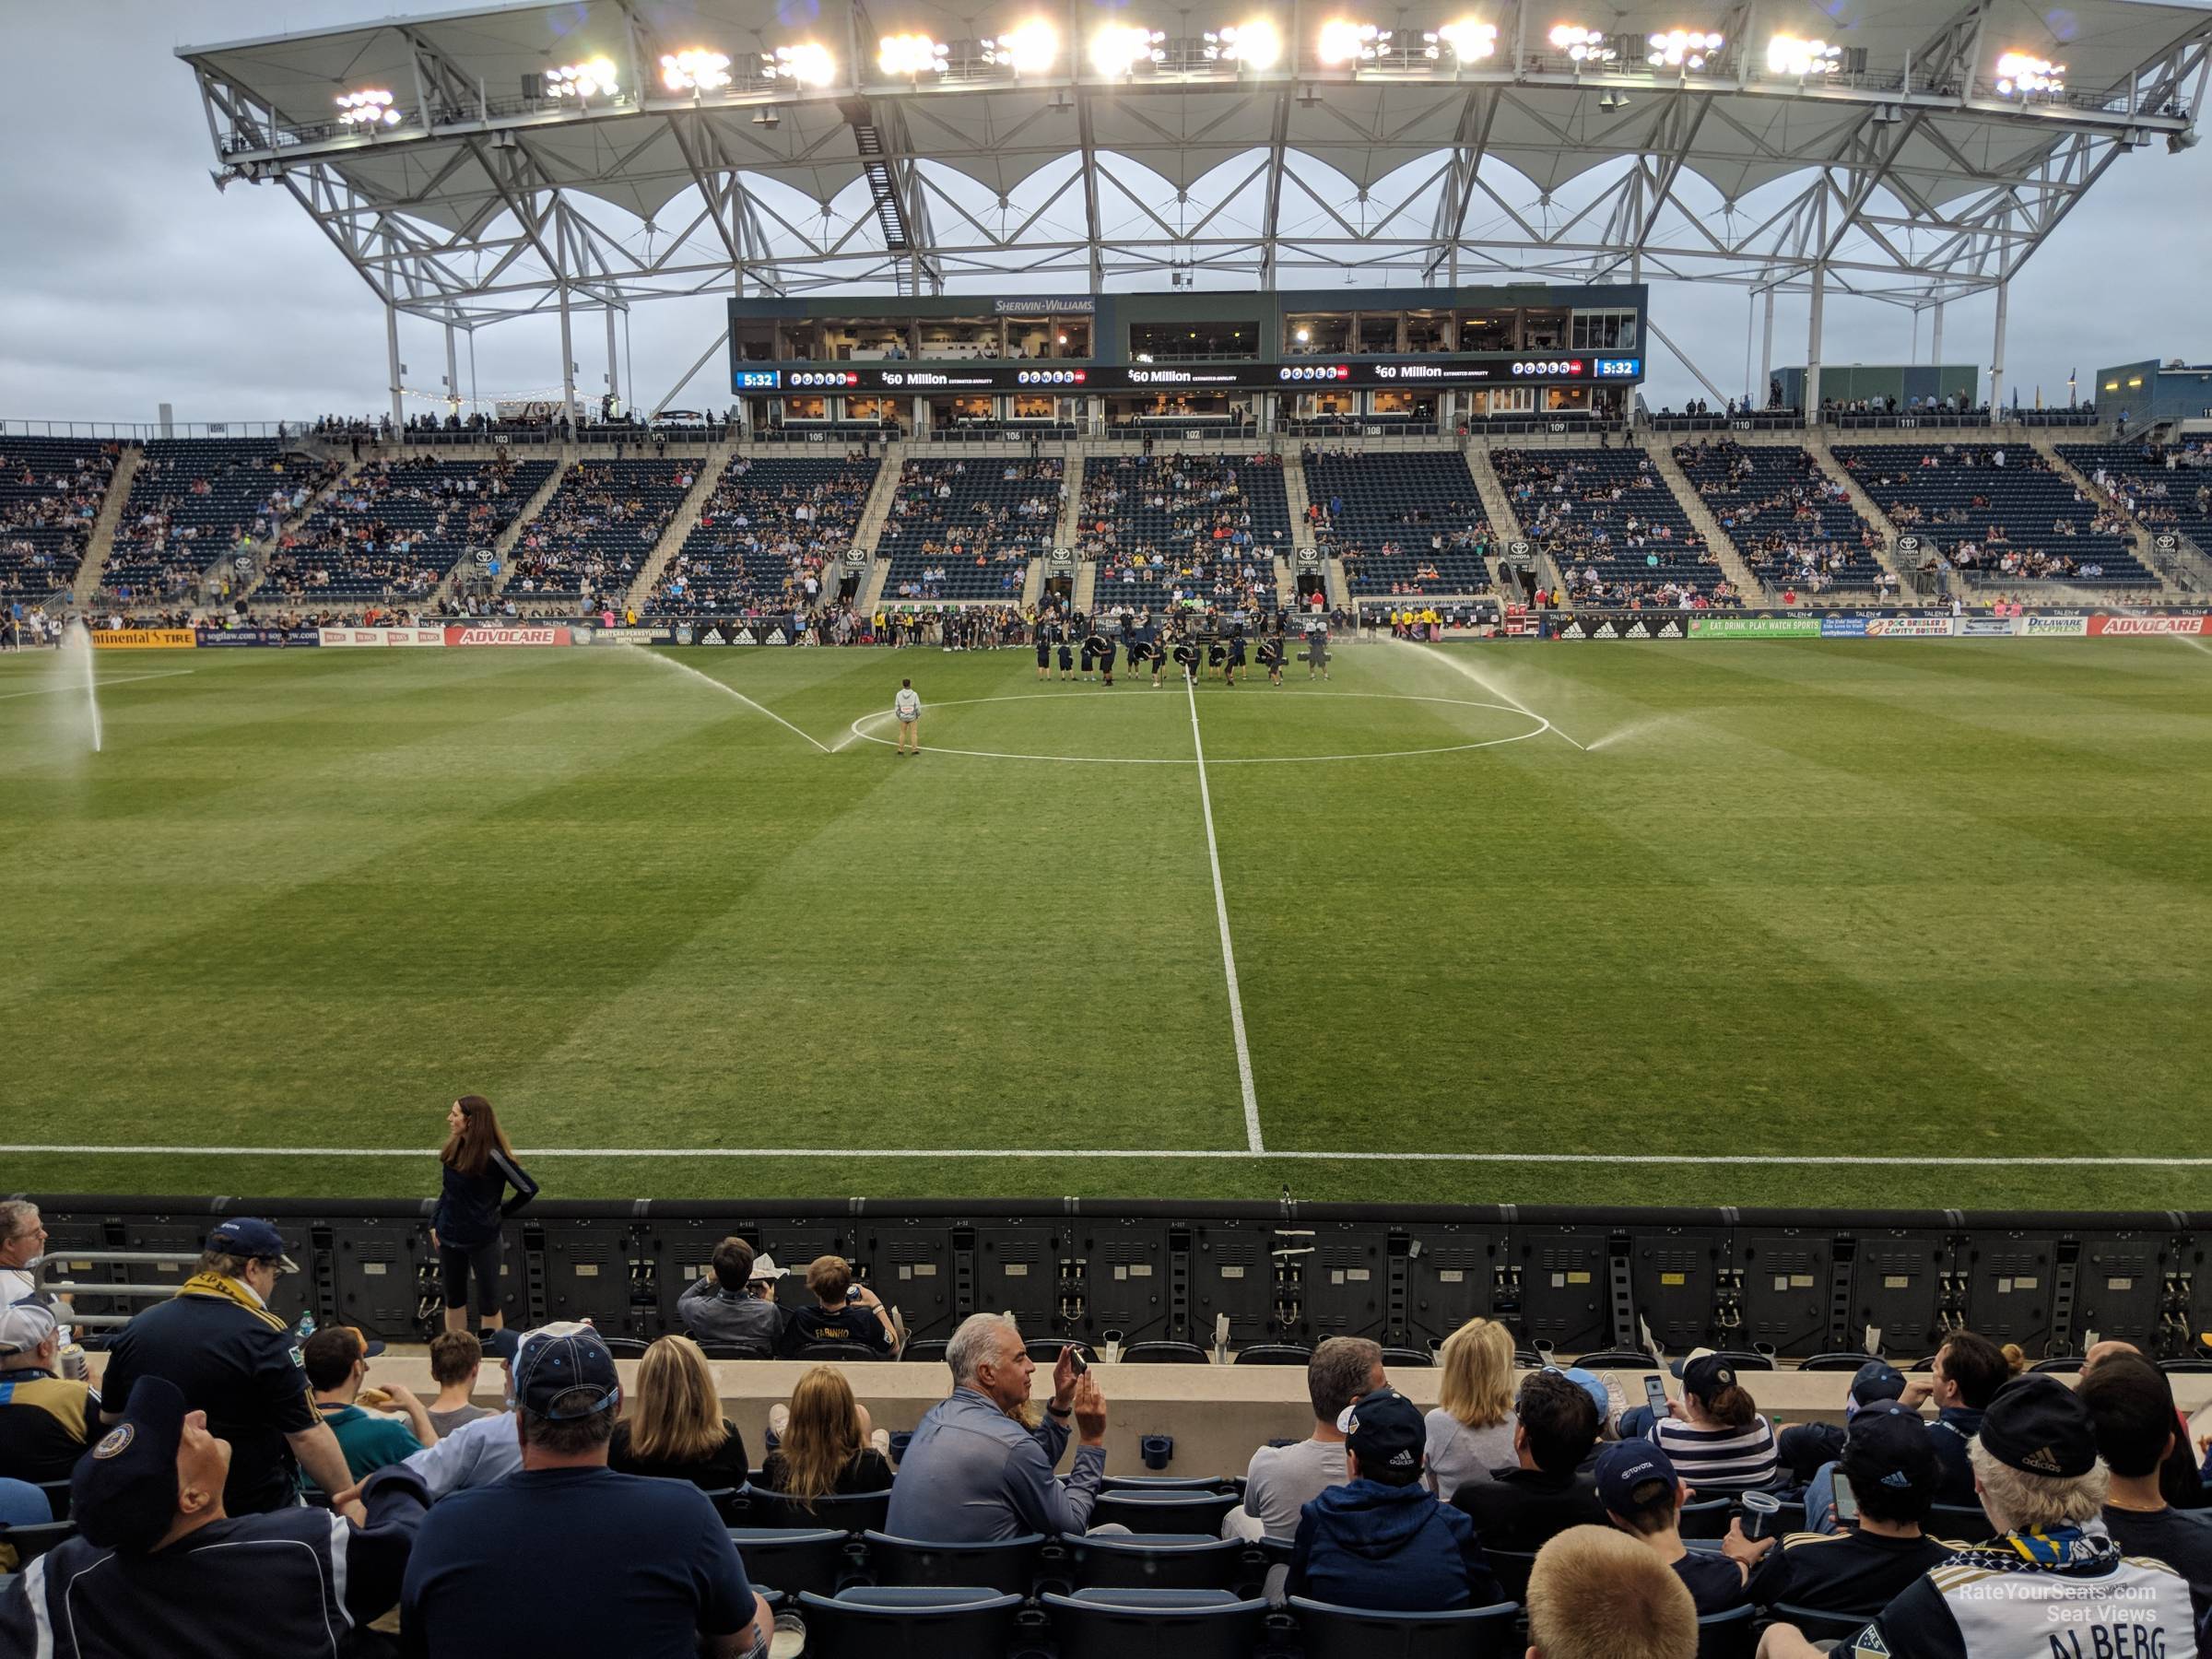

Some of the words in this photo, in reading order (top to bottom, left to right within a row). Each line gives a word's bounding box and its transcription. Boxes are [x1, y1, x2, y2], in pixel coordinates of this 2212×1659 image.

[995, 300, 1092, 312] SHERWIN-WILLIAMS
[1375, 365, 1396, 378] $60
[1401, 366, 1441, 378] Million
[1603, 362, 1632, 374] 5:32
[744, 374, 772, 386] 5:32
[882, 371, 903, 385] $60
[907, 373, 947, 384] Million
[1128, 369, 1148, 382] $60
[1150, 371, 1191, 382] Million
[1550, 423, 1565, 432] 109
[1735, 420, 1750, 429] 110
[1901, 418, 1915, 428] 111
[808, 432, 823, 441] 105
[1006, 432, 1020, 441] 106
[1185, 430, 1200, 440] 107
[1366, 427, 1381, 436] 108
[494, 435, 508, 443] 103
[1710, 621, 1723, 630] EAT.
[1749, 621, 1767, 629] PLAY.
[1769, 620, 1791, 629] WATCH
[1793, 619, 1818, 629] SPORTS
[2028, 618, 2083, 626] DELAWARE
[2103, 618, 2202, 633] ADVOCARE
[2027, 625, 2083, 634] EXPRESS
[93, 631, 149, 644] ntinental
[165, 633, 192, 643] TIRE
[461, 629, 554, 643] ADVOCARE
[815, 1327, 850, 1339] FABINHO
[1630, 1461, 1654, 1475] TOYOTA
[2021, 1456, 2062, 1473] adidas
[1866, 1629, 1881, 1649] MLS
